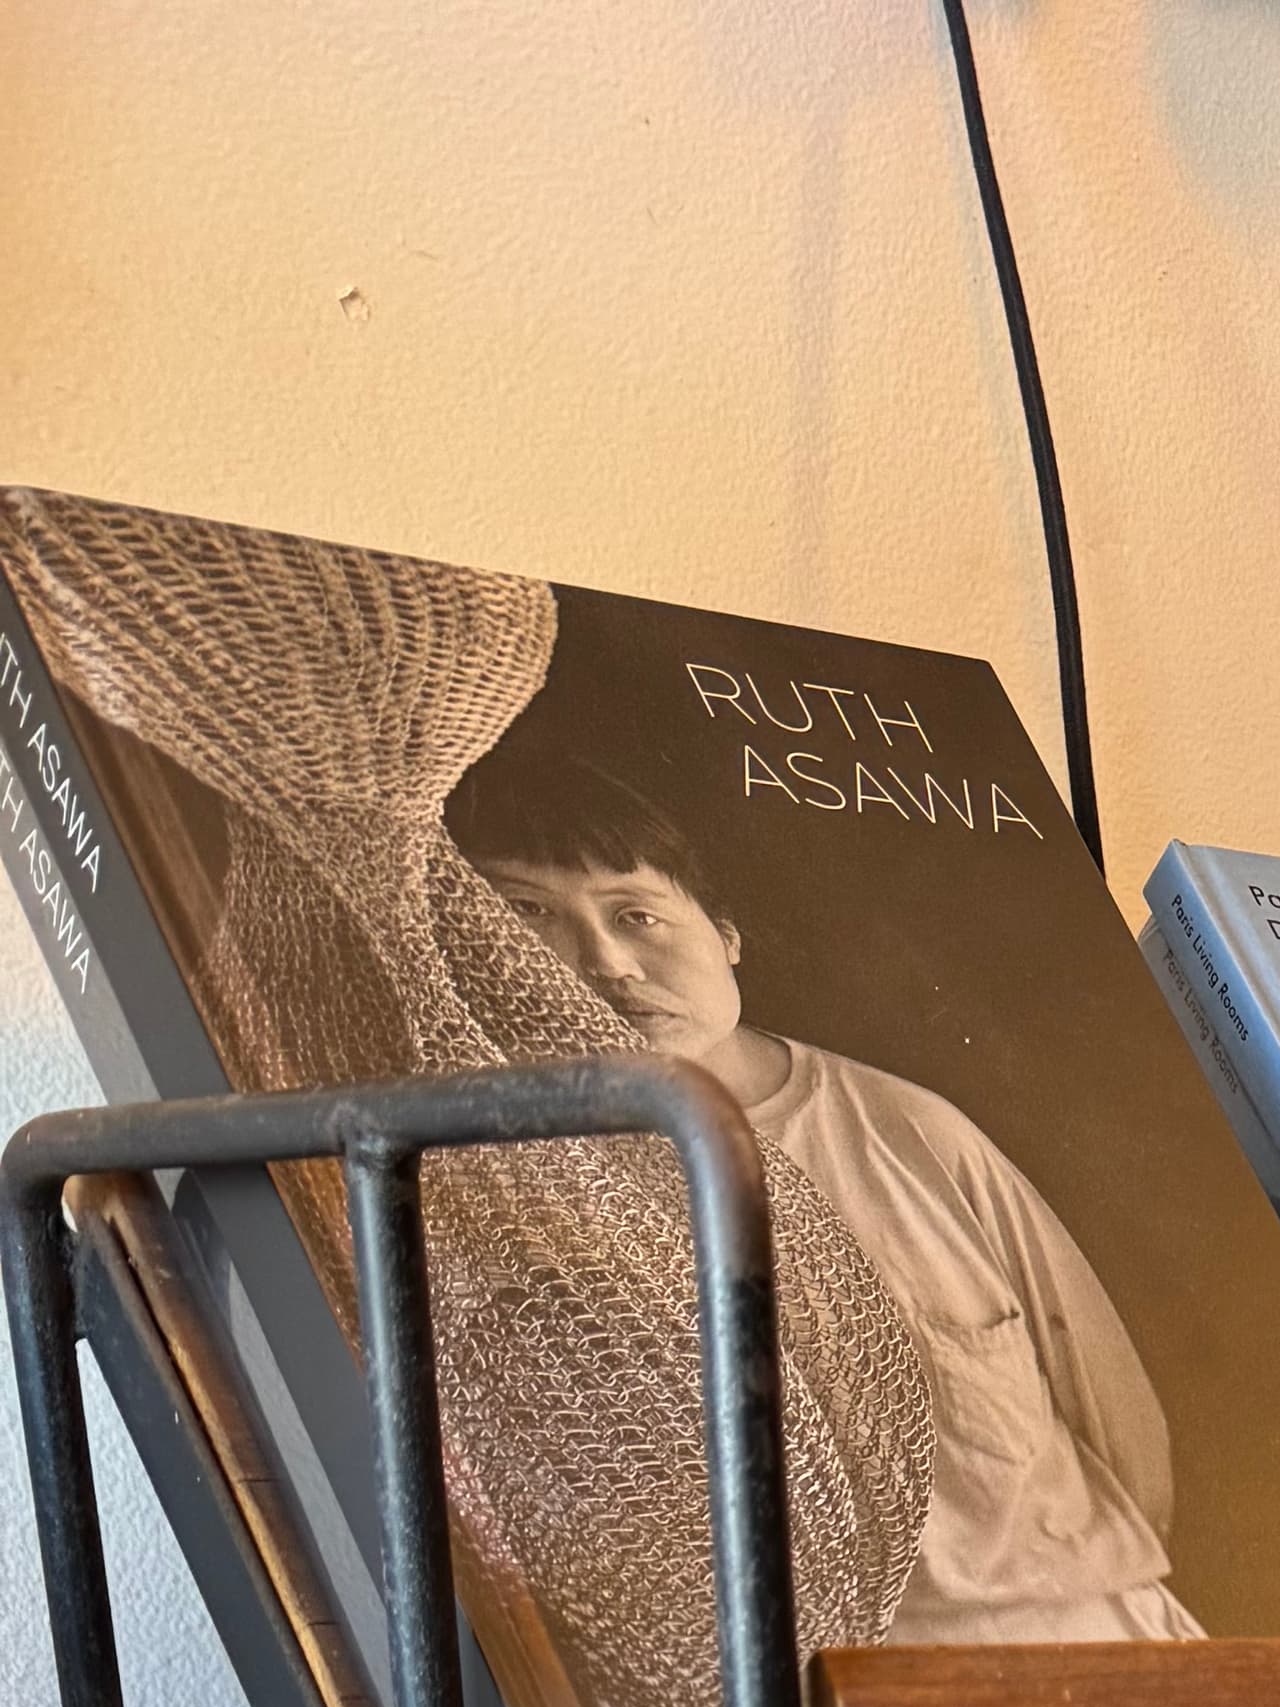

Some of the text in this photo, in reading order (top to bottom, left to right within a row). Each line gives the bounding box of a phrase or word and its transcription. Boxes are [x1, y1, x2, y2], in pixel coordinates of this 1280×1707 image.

[685, 662, 934, 753] RUTH
[27, 722, 101, 893] ASAWA
[744, 744, 1043, 840] ASAWA
[19, 829, 91, 994] ASAWA
[1171, 894, 1249, 1042] Paris Living Rooms
[1163, 948, 1238, 1096] Paris Living Rooms
